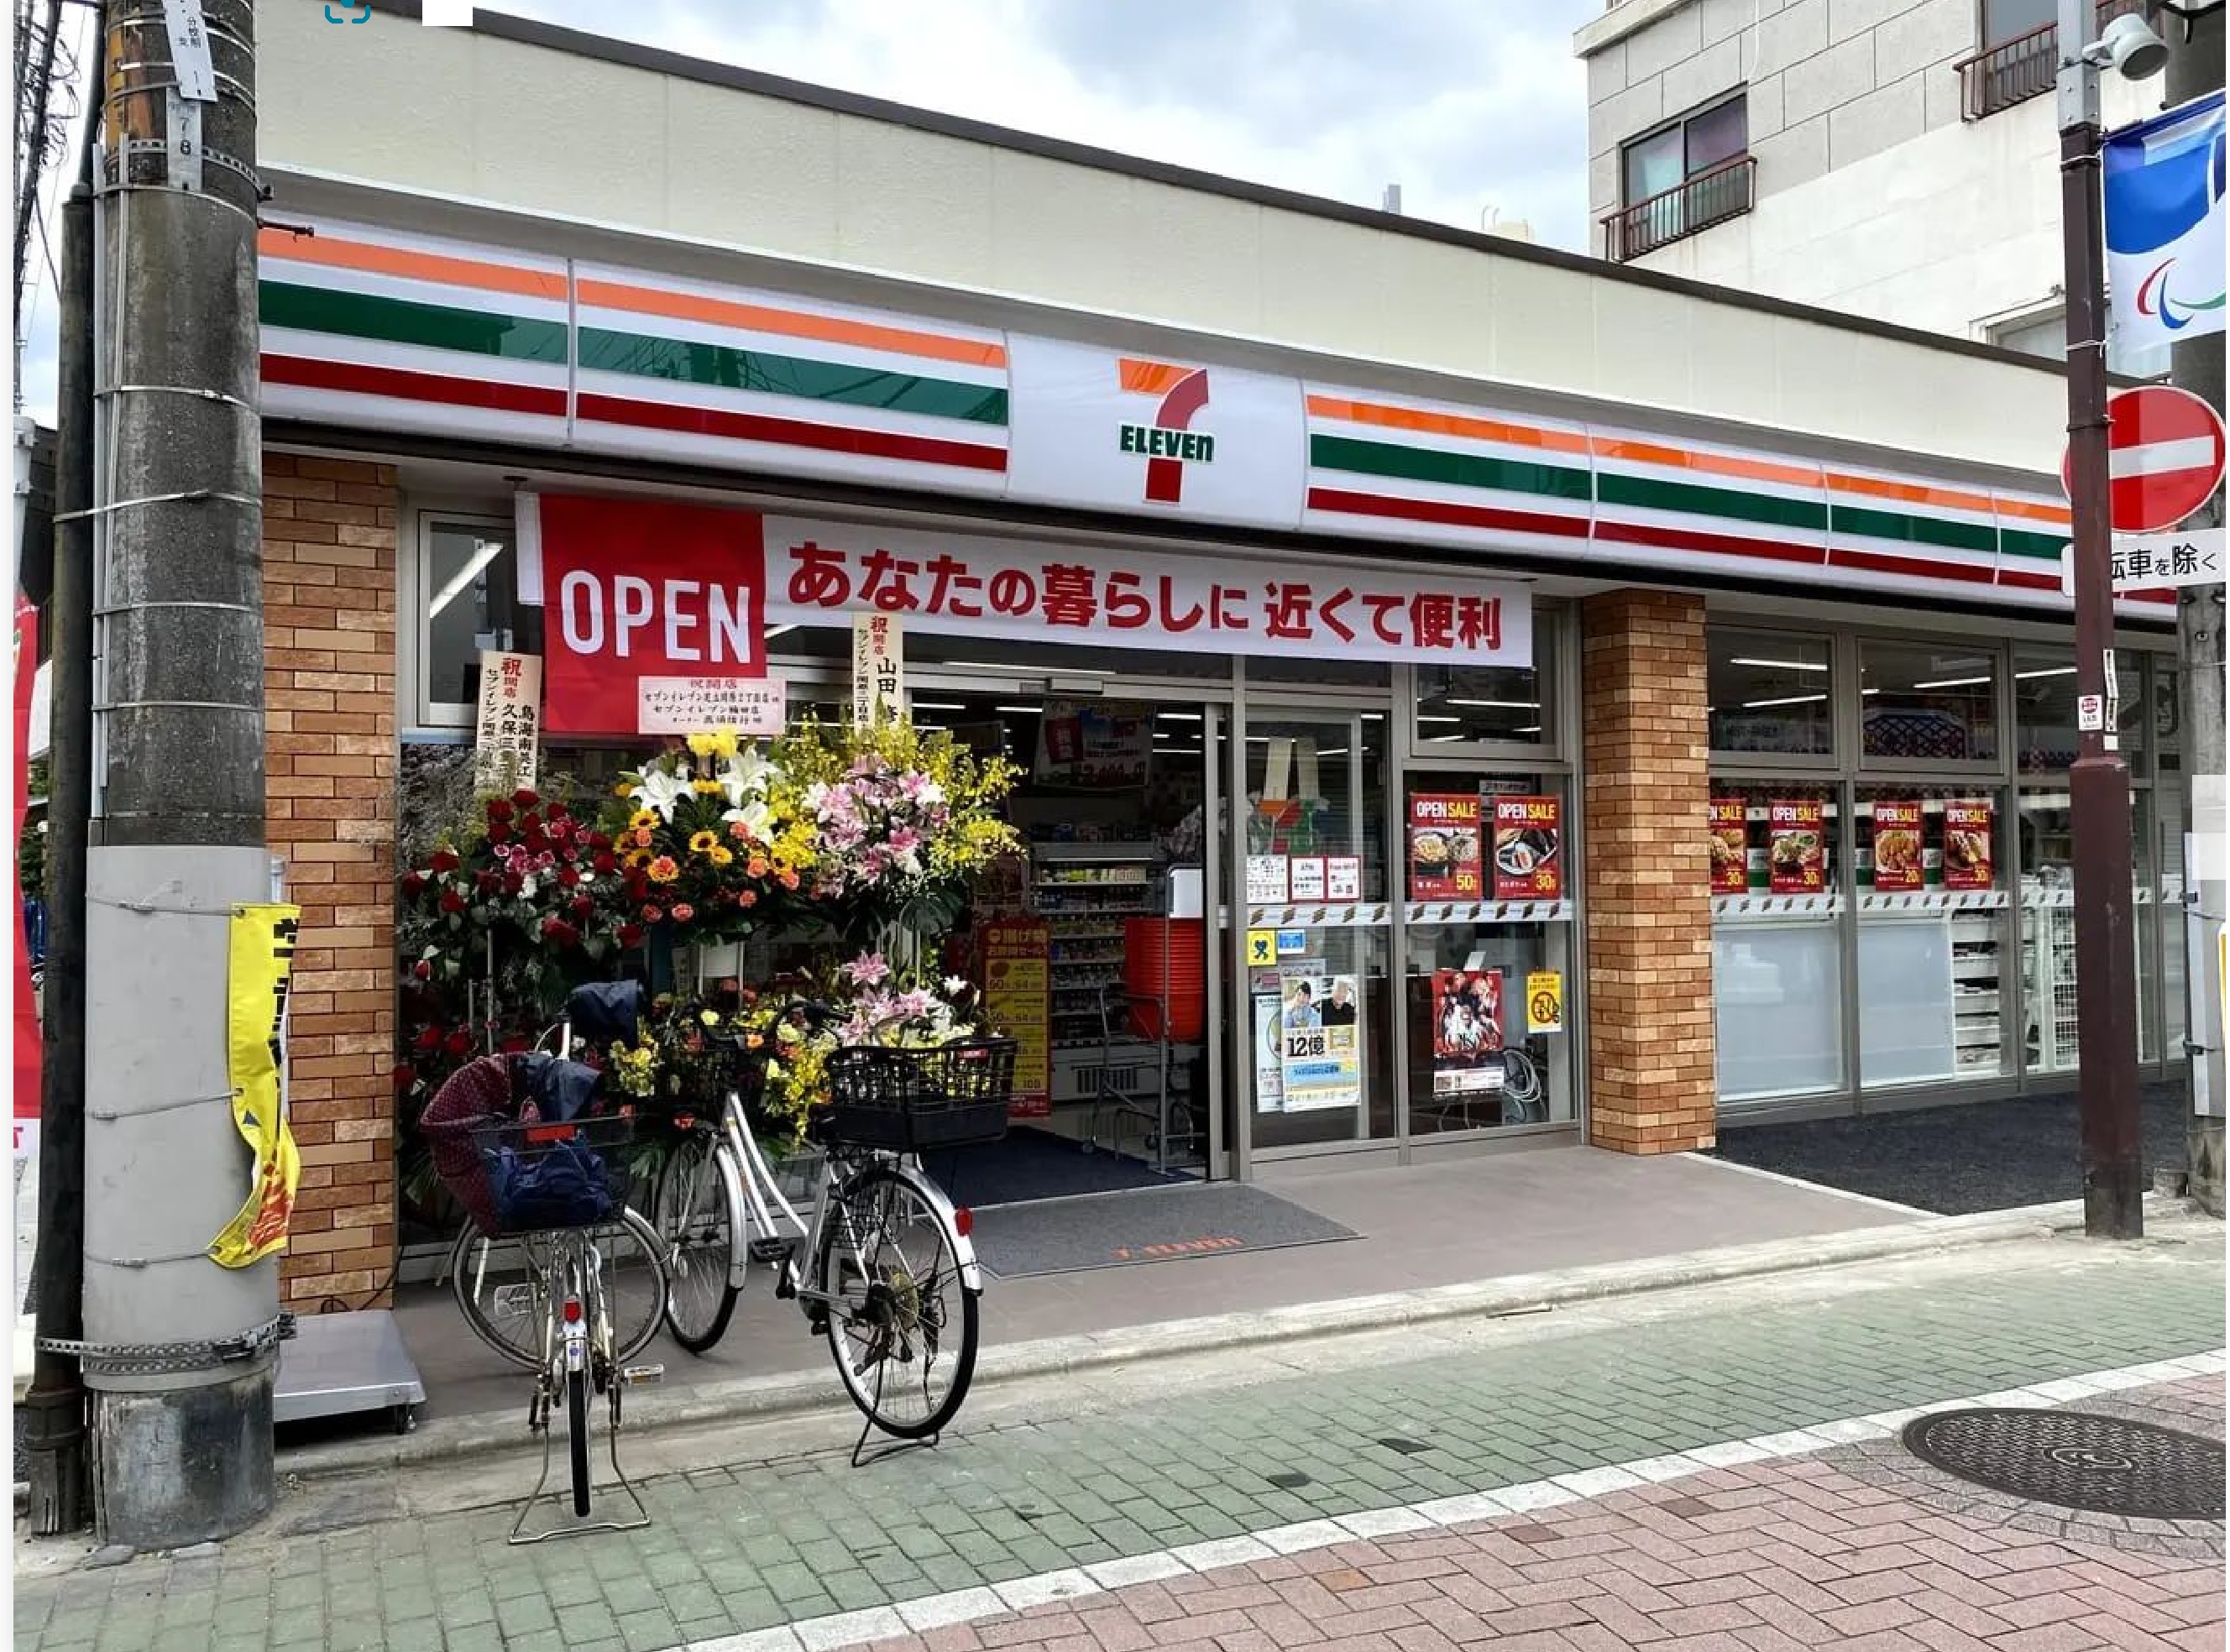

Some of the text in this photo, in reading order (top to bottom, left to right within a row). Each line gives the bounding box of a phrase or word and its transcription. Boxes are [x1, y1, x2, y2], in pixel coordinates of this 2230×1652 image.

[2112, 542, 2217, 580] 転車を除く
[788, 541, 1501, 651] あなたの暮らしに 近くて便利
[561, 569, 751, 663] OPEN
[1416, 801, 1478, 818] OPEN SALE
[1498, 803, 1557, 819] OPEN SALE
[1719, 806, 1743, 820] SALE
[1772, 807, 1819, 821] OPEN SALE
[1877, 808, 1918, 822] OPEN SALE
[1947, 809, 1987, 822] OPEN SALE
[1286, 1035, 1326, 1058] 12億
